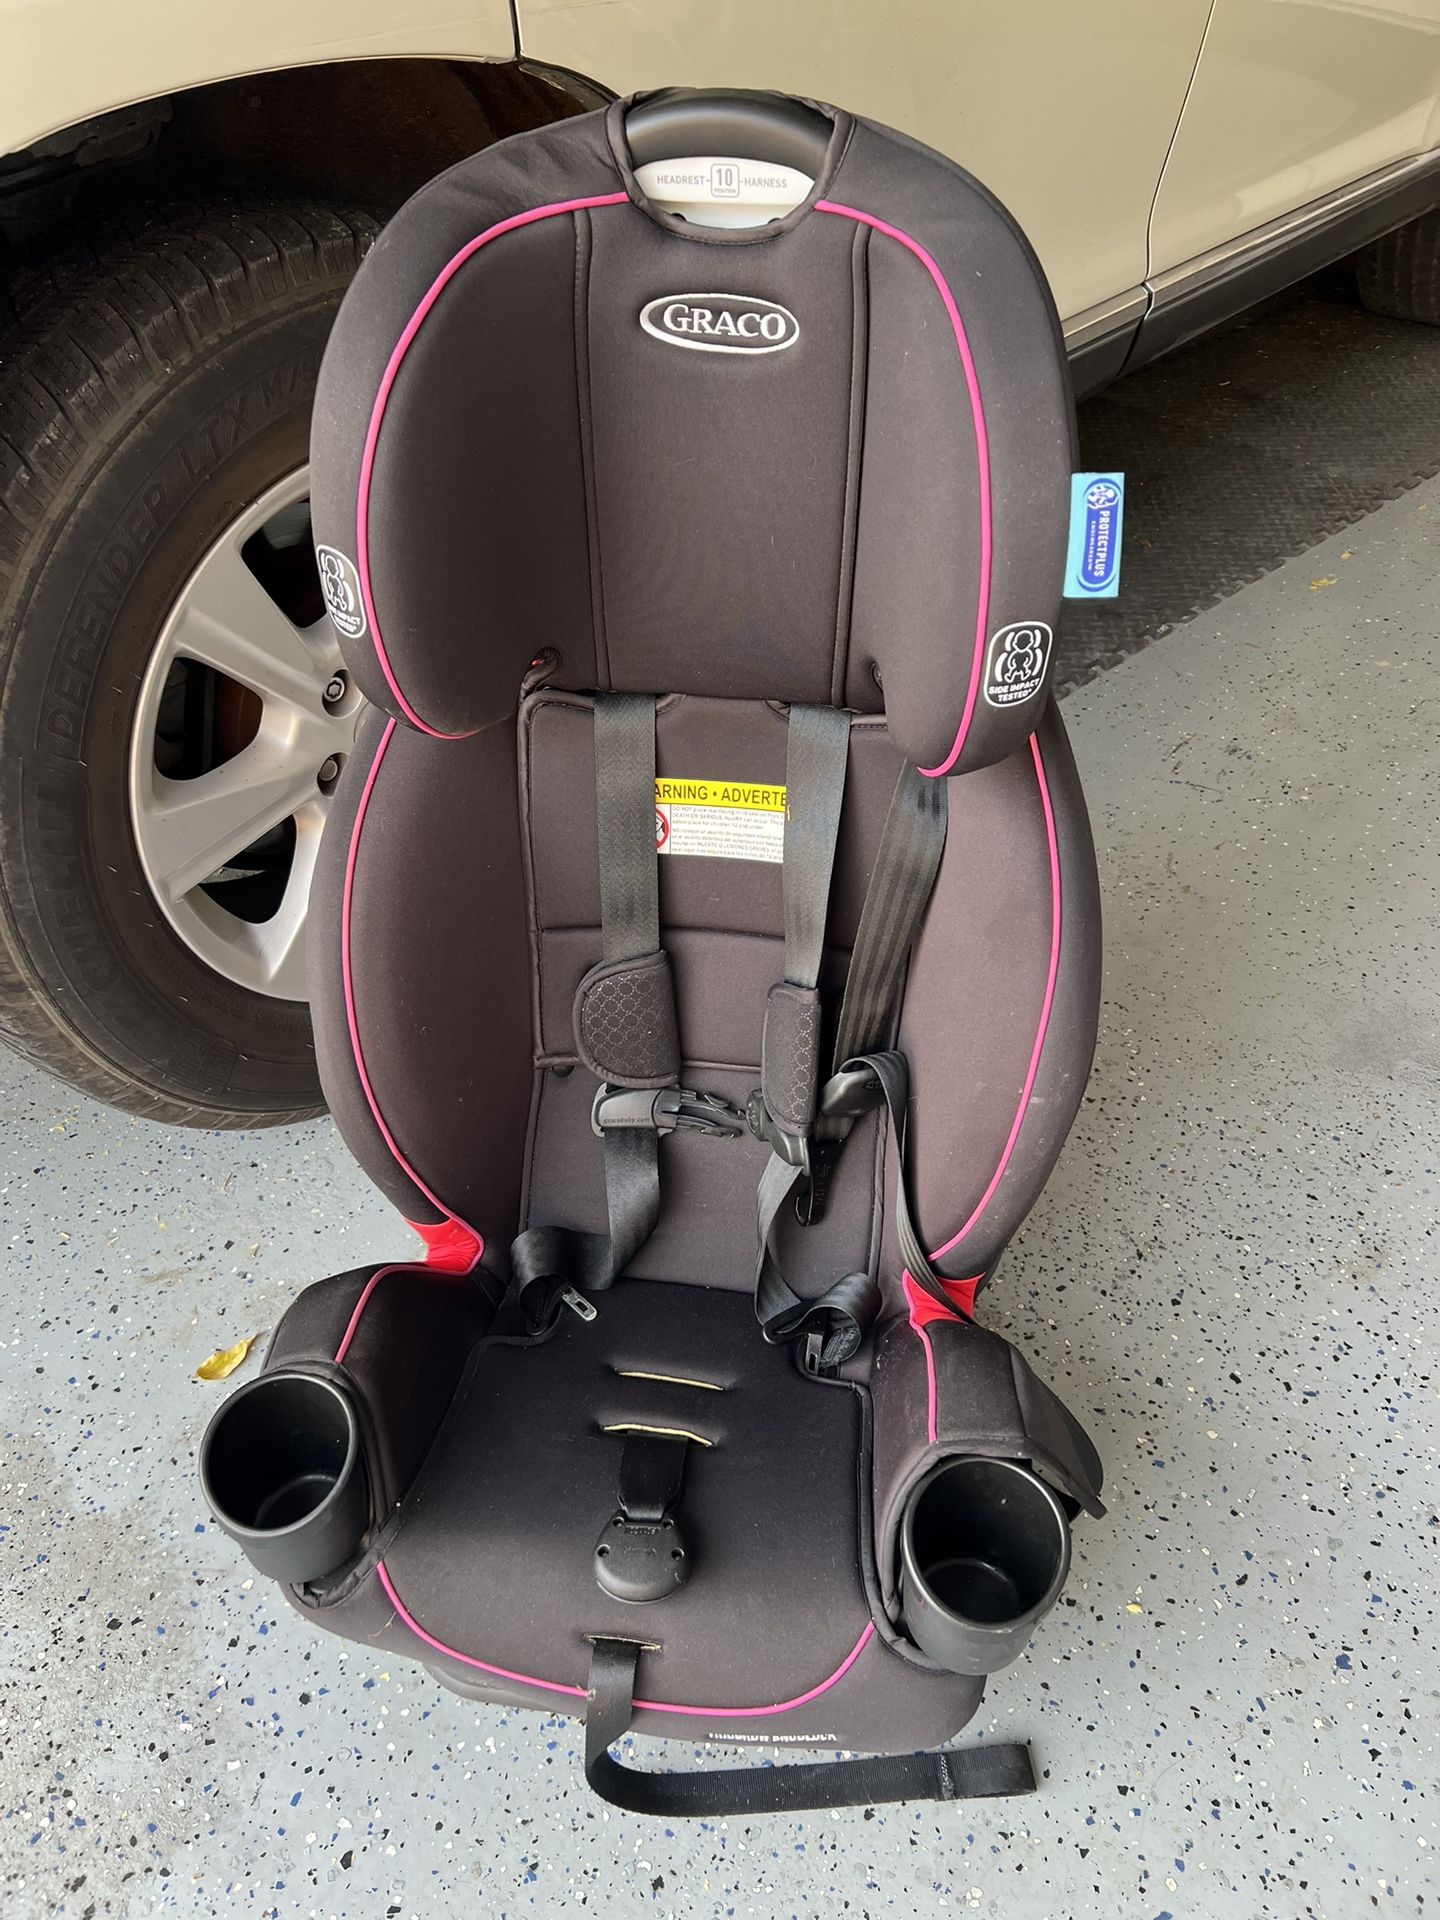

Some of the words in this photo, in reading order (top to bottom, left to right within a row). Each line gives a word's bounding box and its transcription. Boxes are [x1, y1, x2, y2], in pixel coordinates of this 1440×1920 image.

[657, 175, 705, 185] HEADREST
[716, 168, 733, 187] 10
[744, 177, 787, 188] HARNESS
[663, 303, 787, 340] GRACO
[1093, 510, 1111, 577] PROTECTPLUS
[47, 483, 169, 742] DEFENDER
[180, 392, 253, 482] LTX
[988, 684, 1009, 694] SIDE
[1010, 678, 1040, 692] IMPACT
